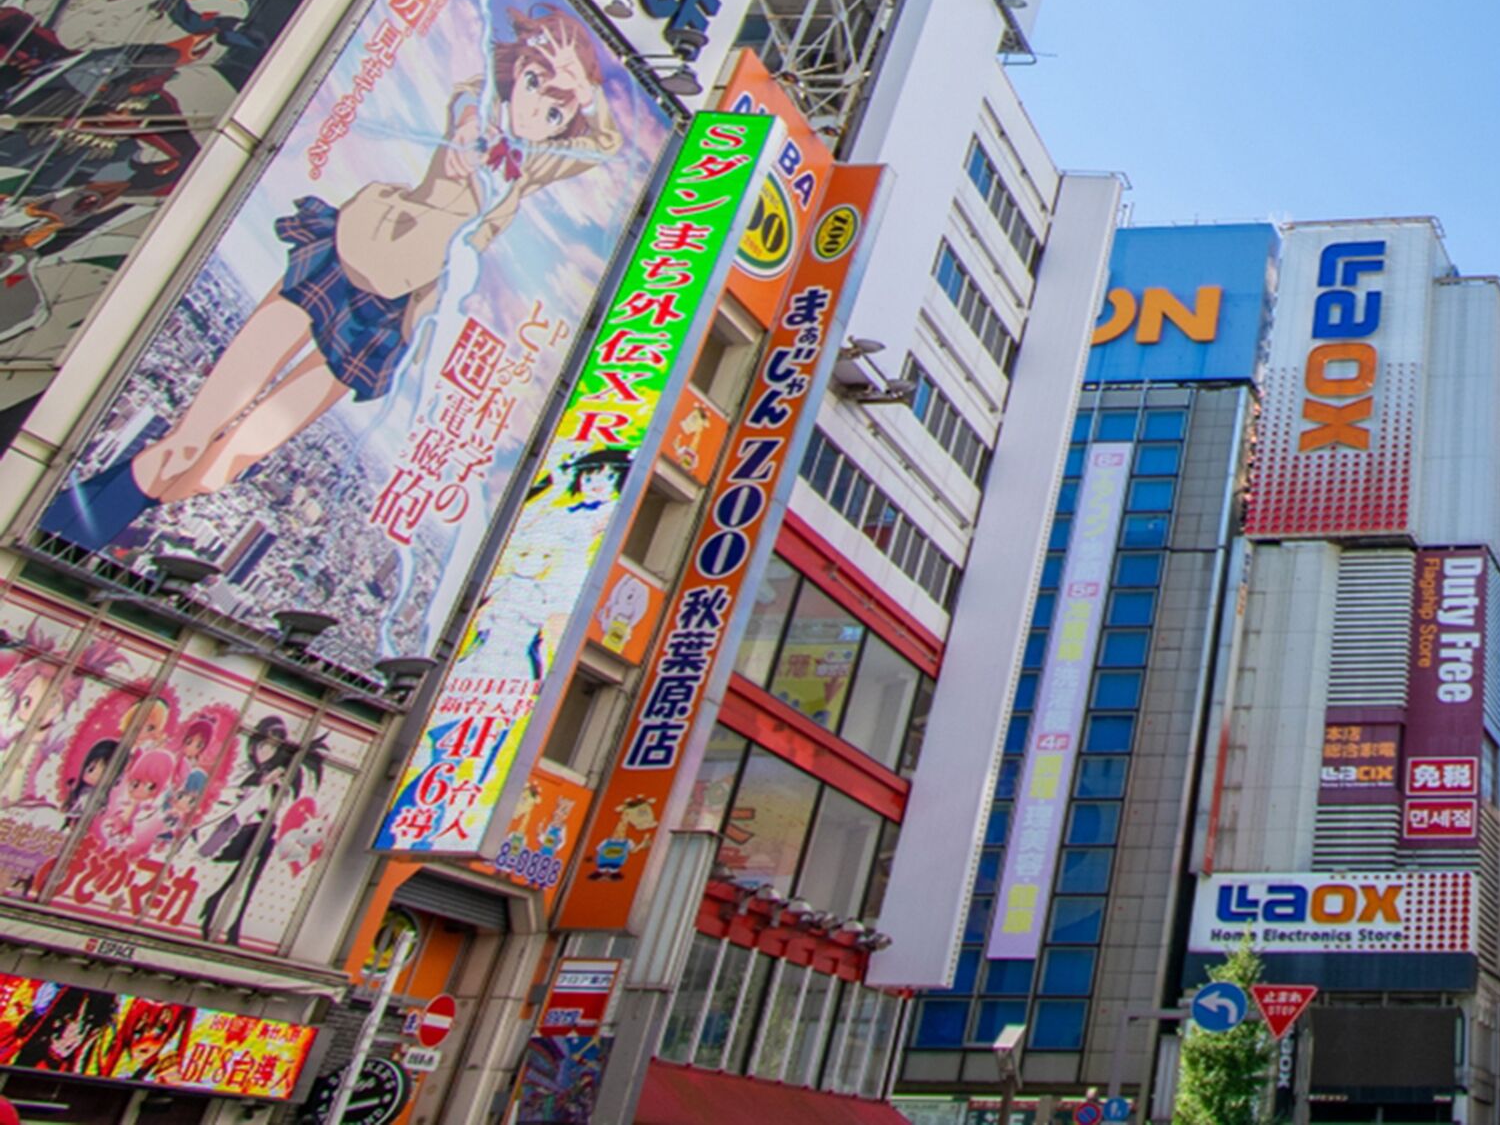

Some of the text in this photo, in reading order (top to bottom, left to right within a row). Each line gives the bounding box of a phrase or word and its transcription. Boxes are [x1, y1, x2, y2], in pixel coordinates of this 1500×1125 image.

[572, 124, 750, 446] Sダンまち外伝XR
[370, 317, 507, 546] 超電磁砲
[1415, 558, 1440, 668] Flagship Store
[1437, 558, 1483, 704] Duty Free
[440, 716, 512, 761] 4F
[418, 763, 482, 807] 6台
[1412, 764, 1472, 789] 免税
[395, 807, 470, 842] 導入
[1211, 928, 1403, 943] Home Electronics Store
[1267, 1005, 1297, 1016] STOP
